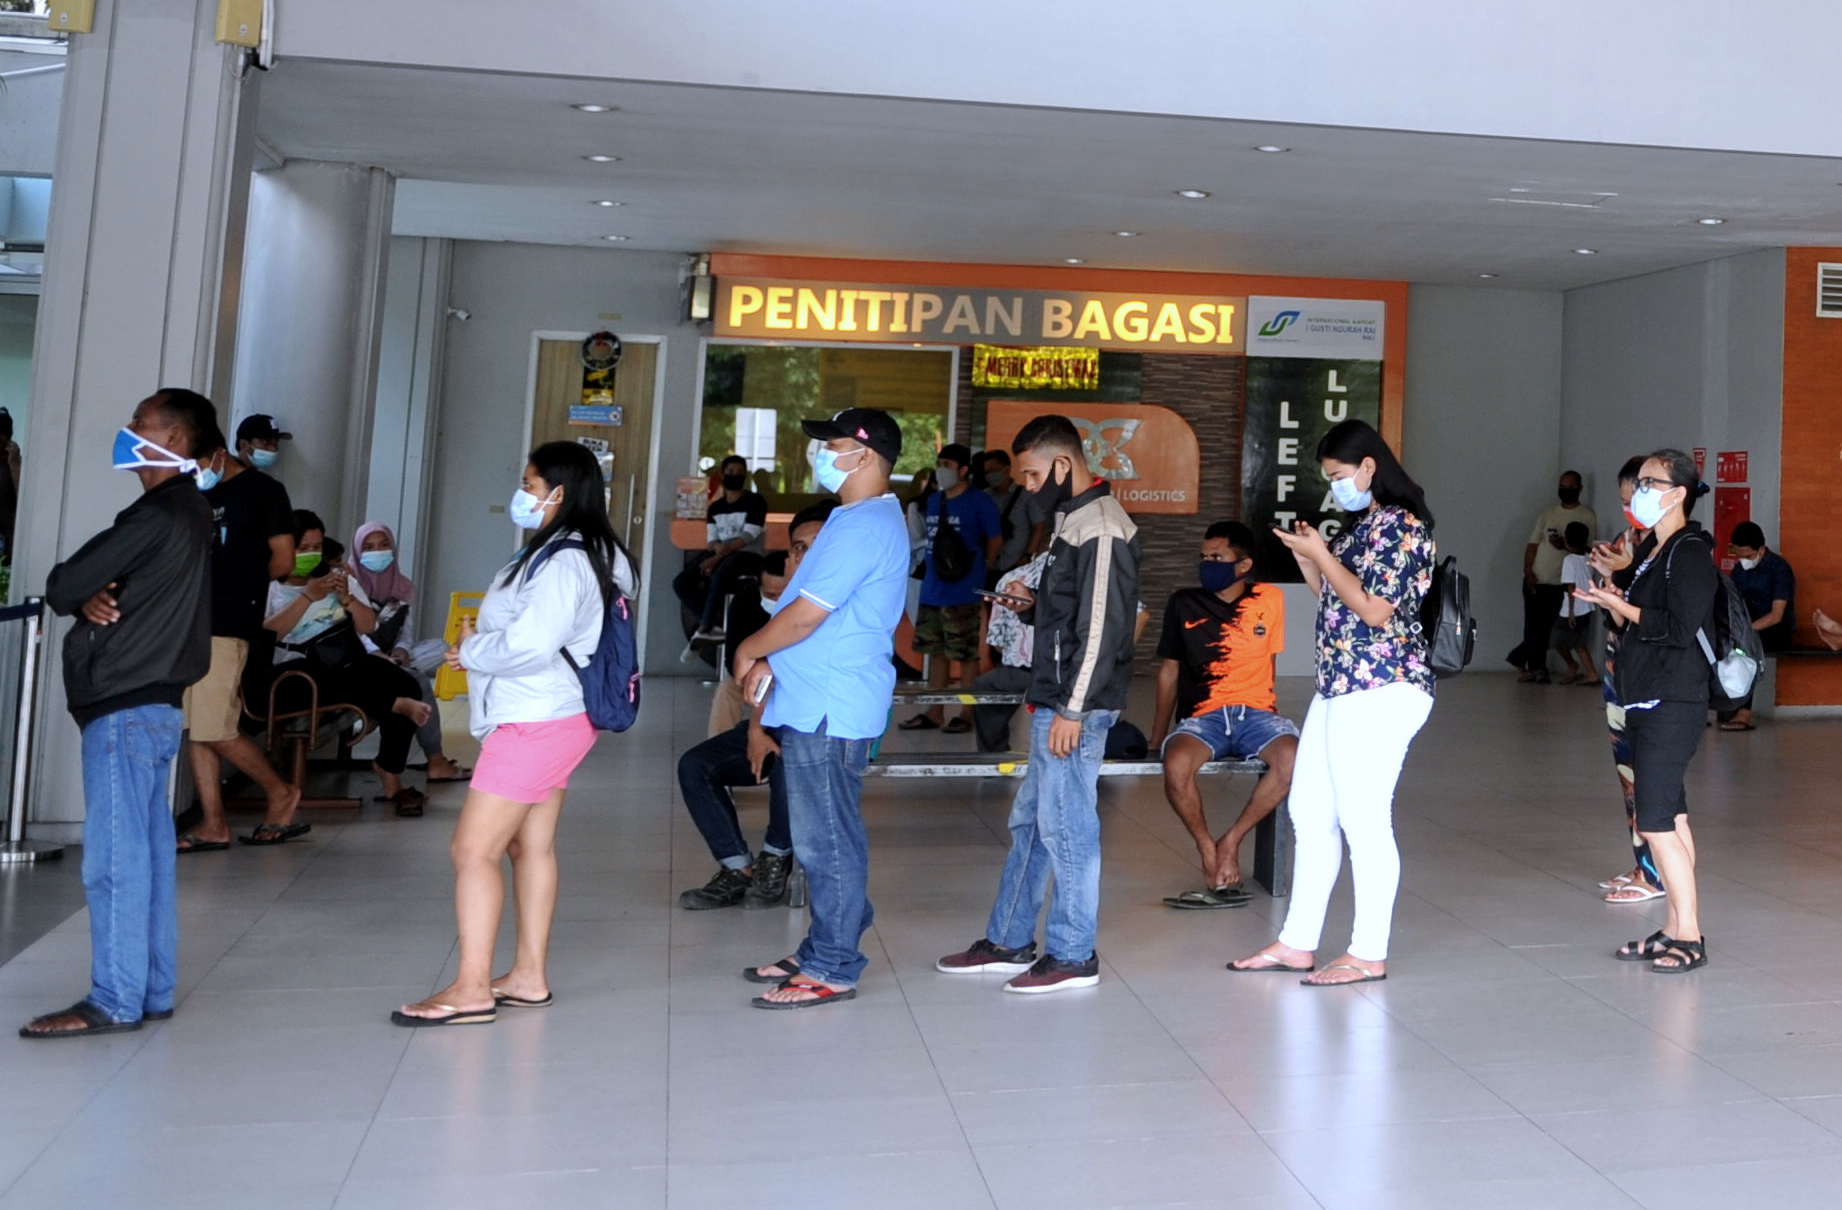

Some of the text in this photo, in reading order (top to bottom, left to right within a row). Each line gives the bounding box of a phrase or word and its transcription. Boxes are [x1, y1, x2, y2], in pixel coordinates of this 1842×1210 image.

[728, 285, 1235, 345] PENITIPAN BAGASI
[1123, 489, 1186, 503] LOGISTICS
[1274, 401, 1299, 532] LEFT
